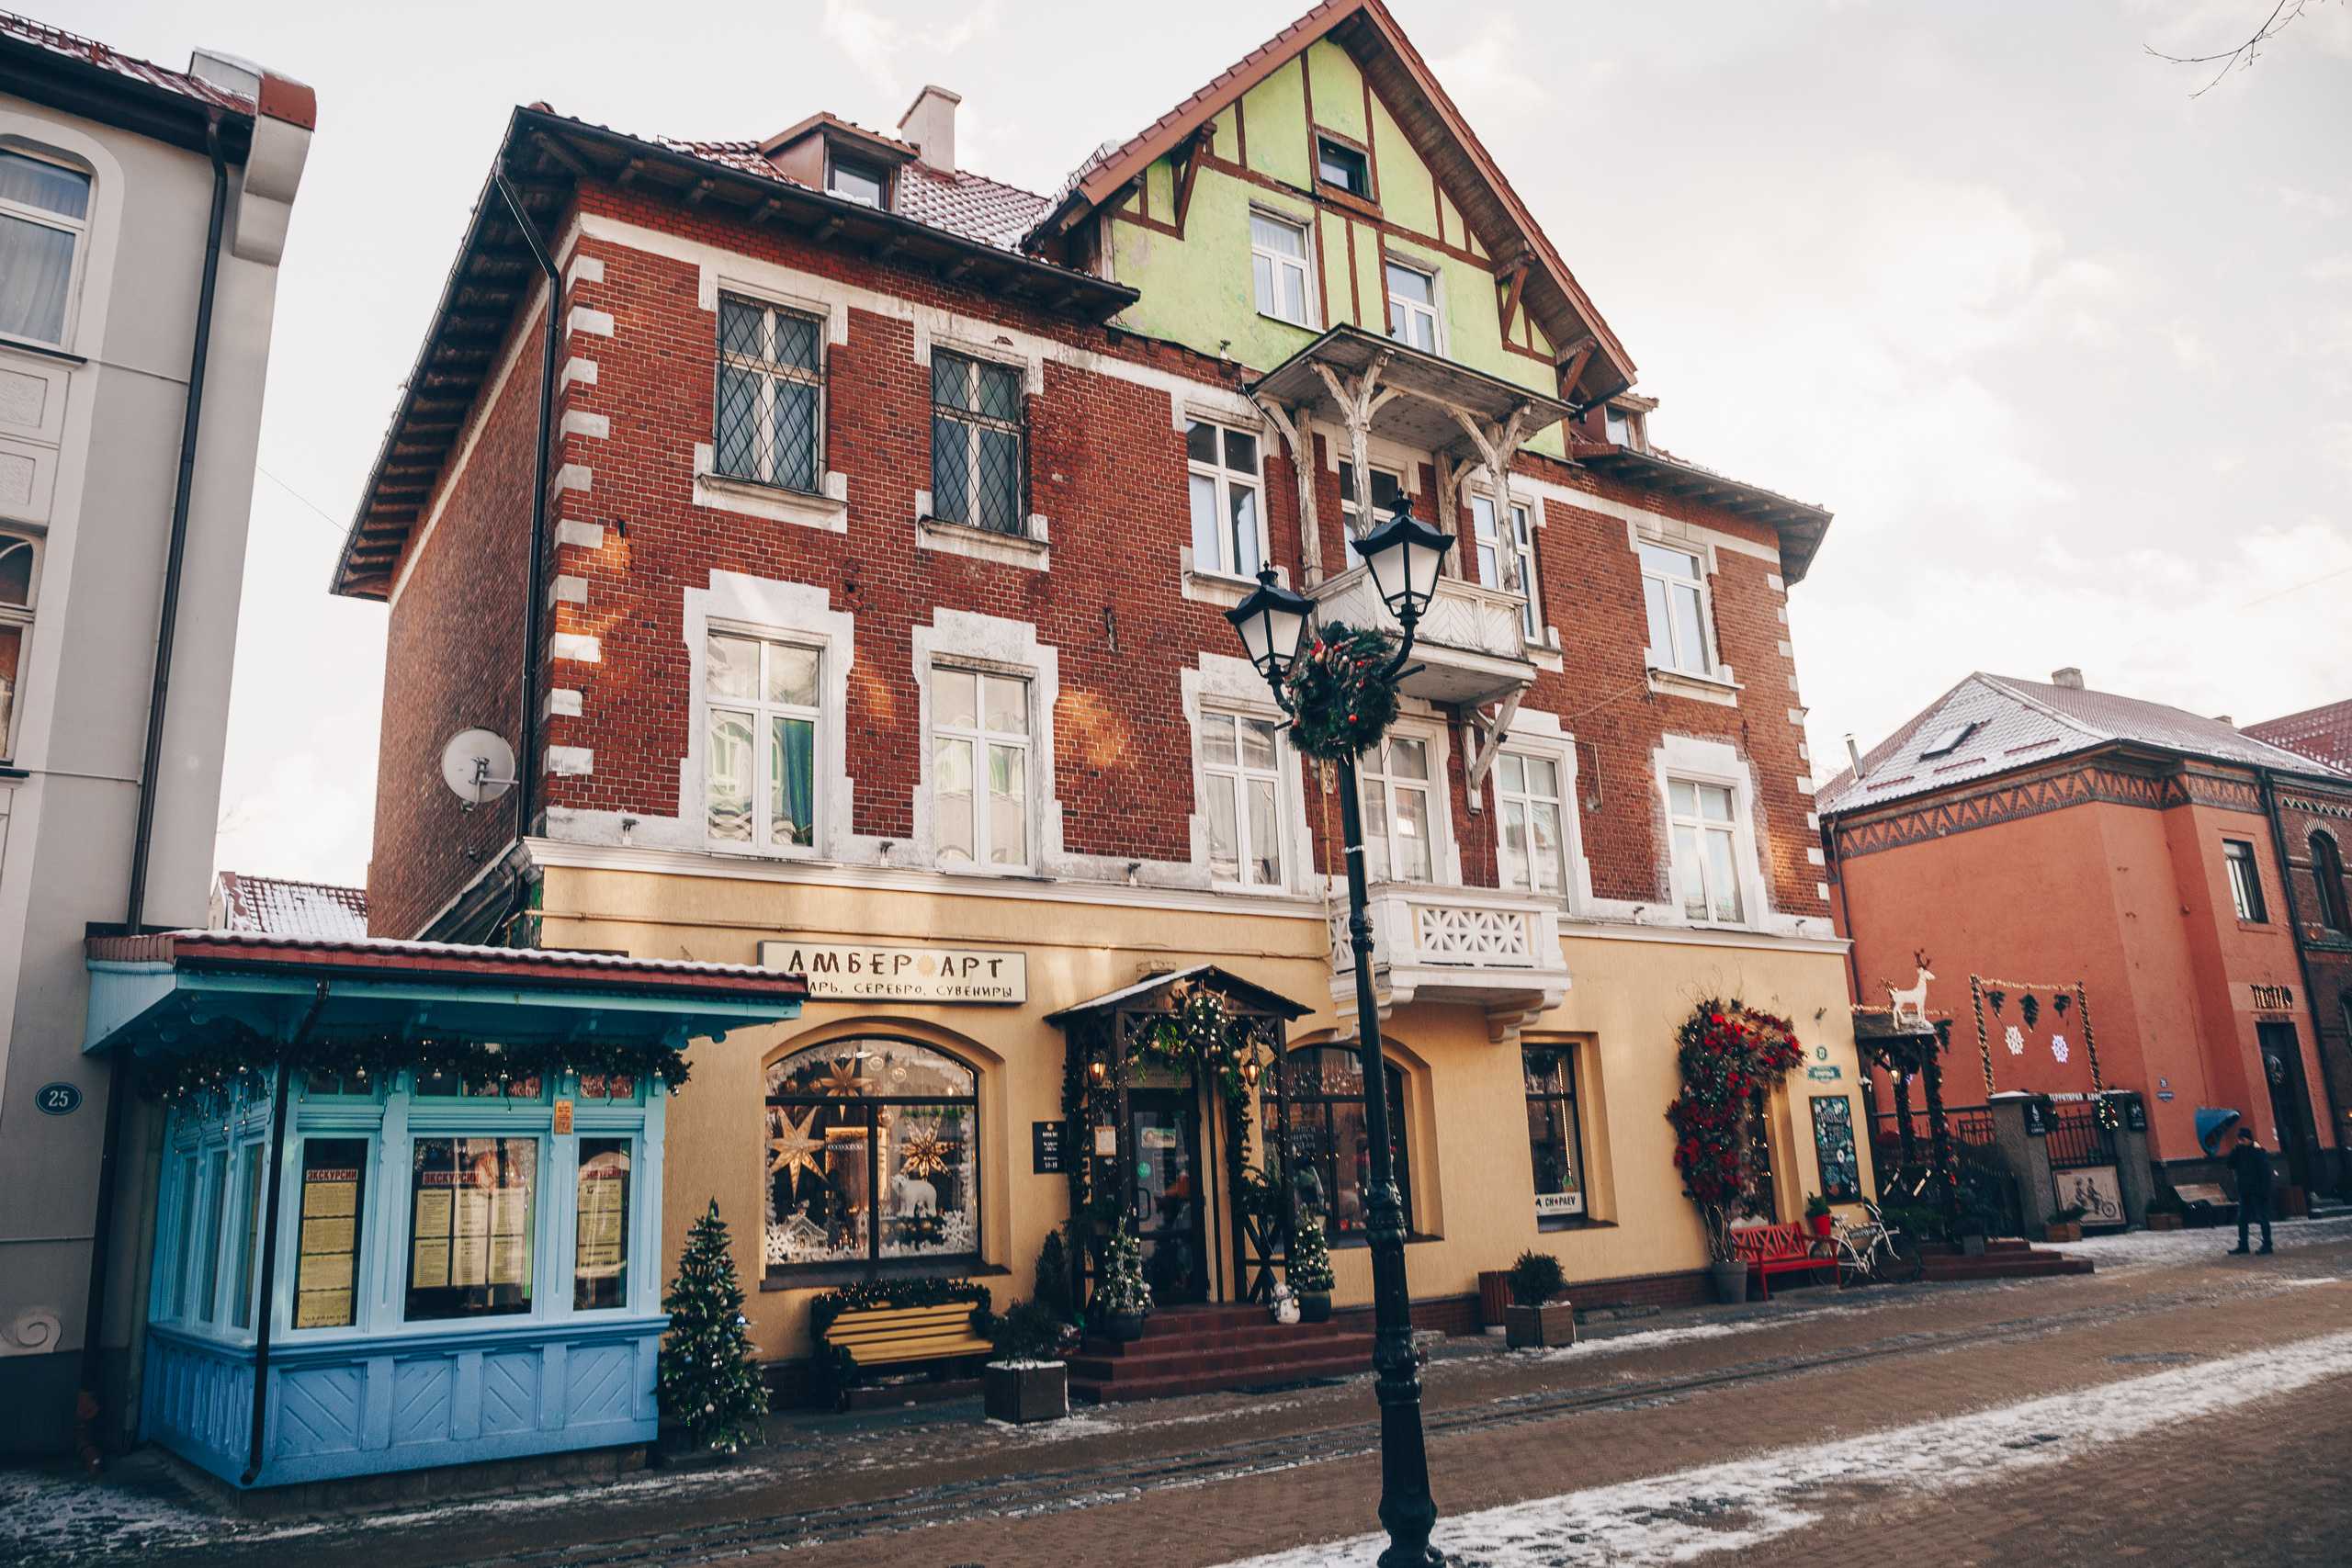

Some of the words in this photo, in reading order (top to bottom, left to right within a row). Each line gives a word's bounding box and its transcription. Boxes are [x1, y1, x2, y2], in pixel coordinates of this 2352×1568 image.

[787, 949, 912, 976] АМБЕР
[940, 956, 1003, 977] АРТ
[808, 981, 843, 994] АРЬ,
[854, 983, 927, 996] СЕРЕБРО,
[936, 986, 1012, 998] СУВЕНИРЫ
[48, 1090, 69, 1107] 25
[307, 1169, 358, 1181] ЭКСКУРСИИ
[424, 1171, 480, 1184] ЭКСКУРСИИ
